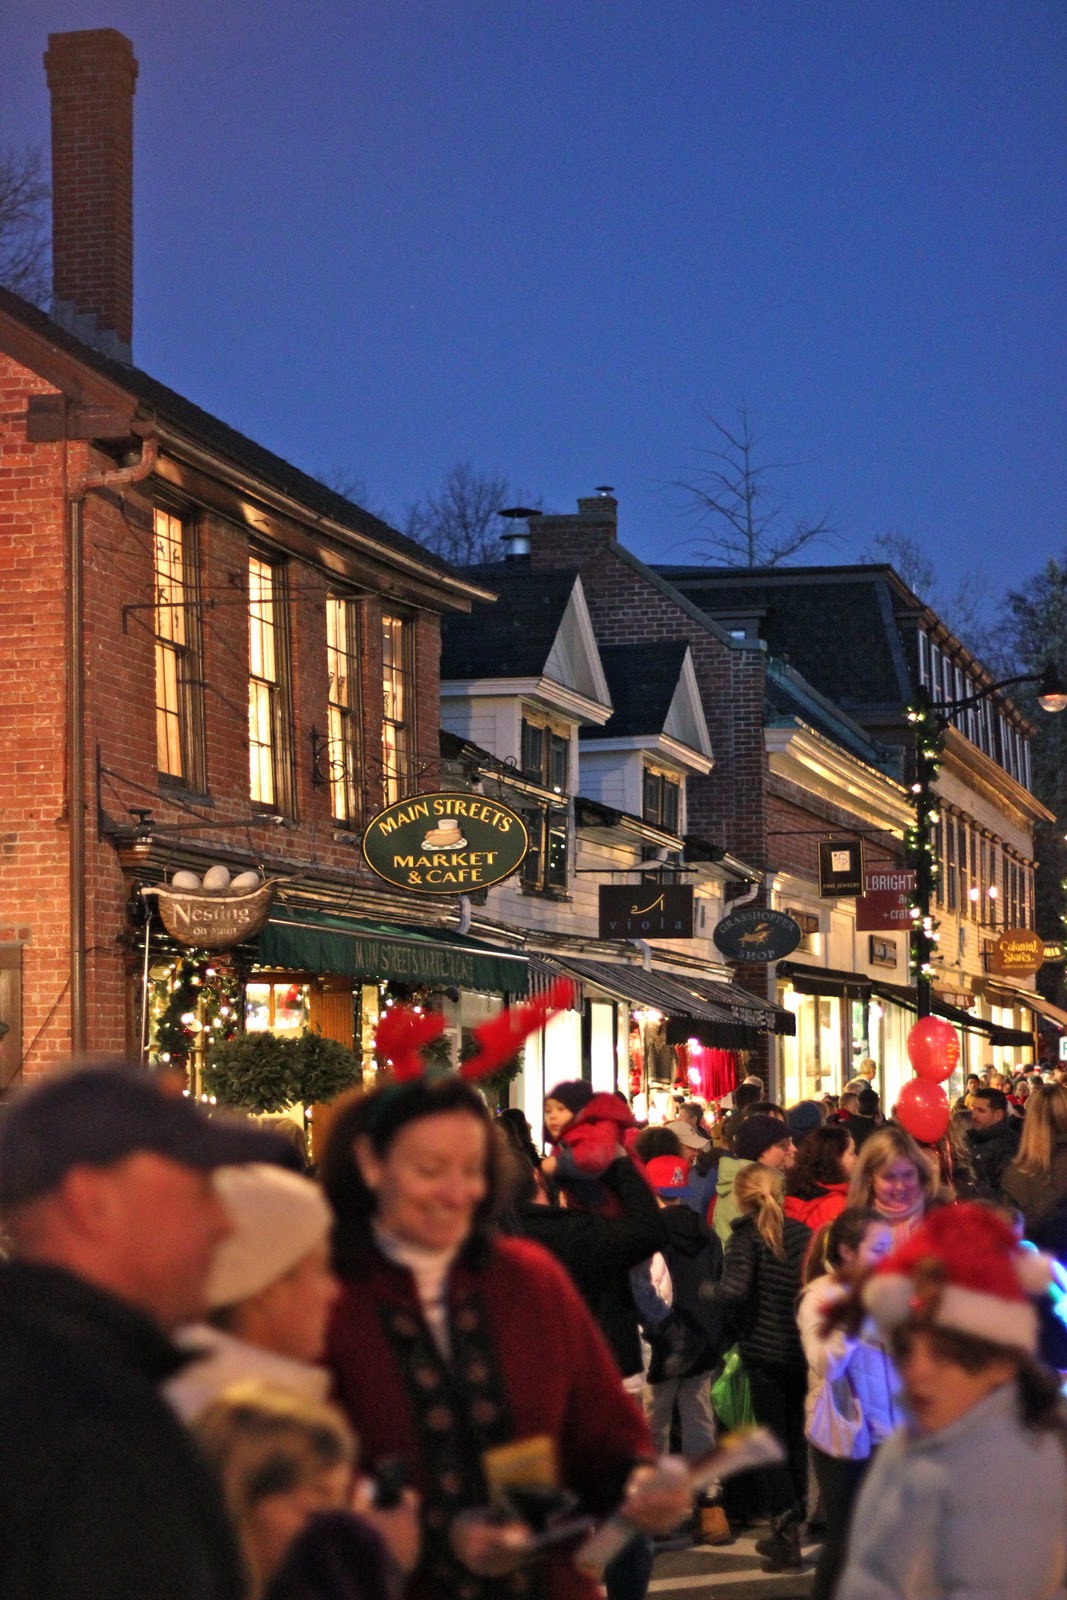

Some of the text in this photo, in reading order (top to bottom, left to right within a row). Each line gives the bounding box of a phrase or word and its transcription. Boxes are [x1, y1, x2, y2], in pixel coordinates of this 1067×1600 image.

[378, 799, 513, 837] MAIN STREETS
[393, 851, 498, 868] MARKET
[407, 868, 483, 884] & CAFE
[865, 874, 914, 891] LBRIGHT
[171, 903, 250, 928] Nesting
[719, 911, 795, 934] GRASSHOPPER
[193, 926, 237, 935] on Main
[609, 918, 683, 930] viola
[999, 940, 1038, 953] Colonial
[737, 949, 775, 961] SHOP
